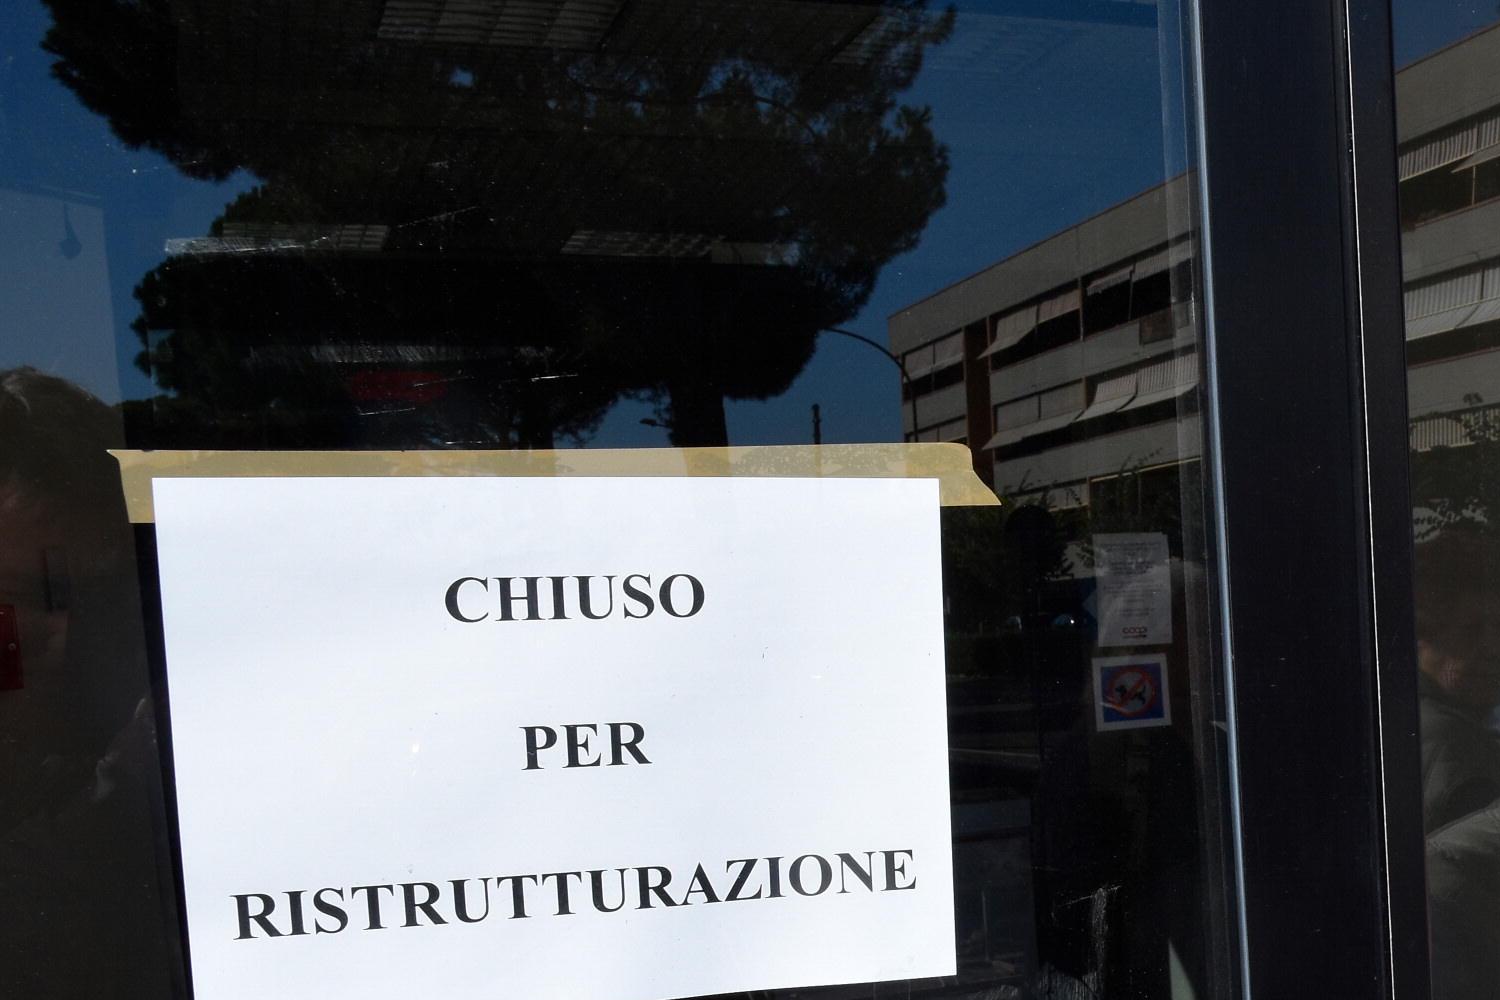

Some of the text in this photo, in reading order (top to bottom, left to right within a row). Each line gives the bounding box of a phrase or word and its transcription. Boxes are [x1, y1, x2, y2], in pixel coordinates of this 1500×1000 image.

[443, 573, 706, 623] CHIUSO
[518, 721, 653, 771] PER
[232, 848, 918, 941] RISTRUTTURAZIONE
